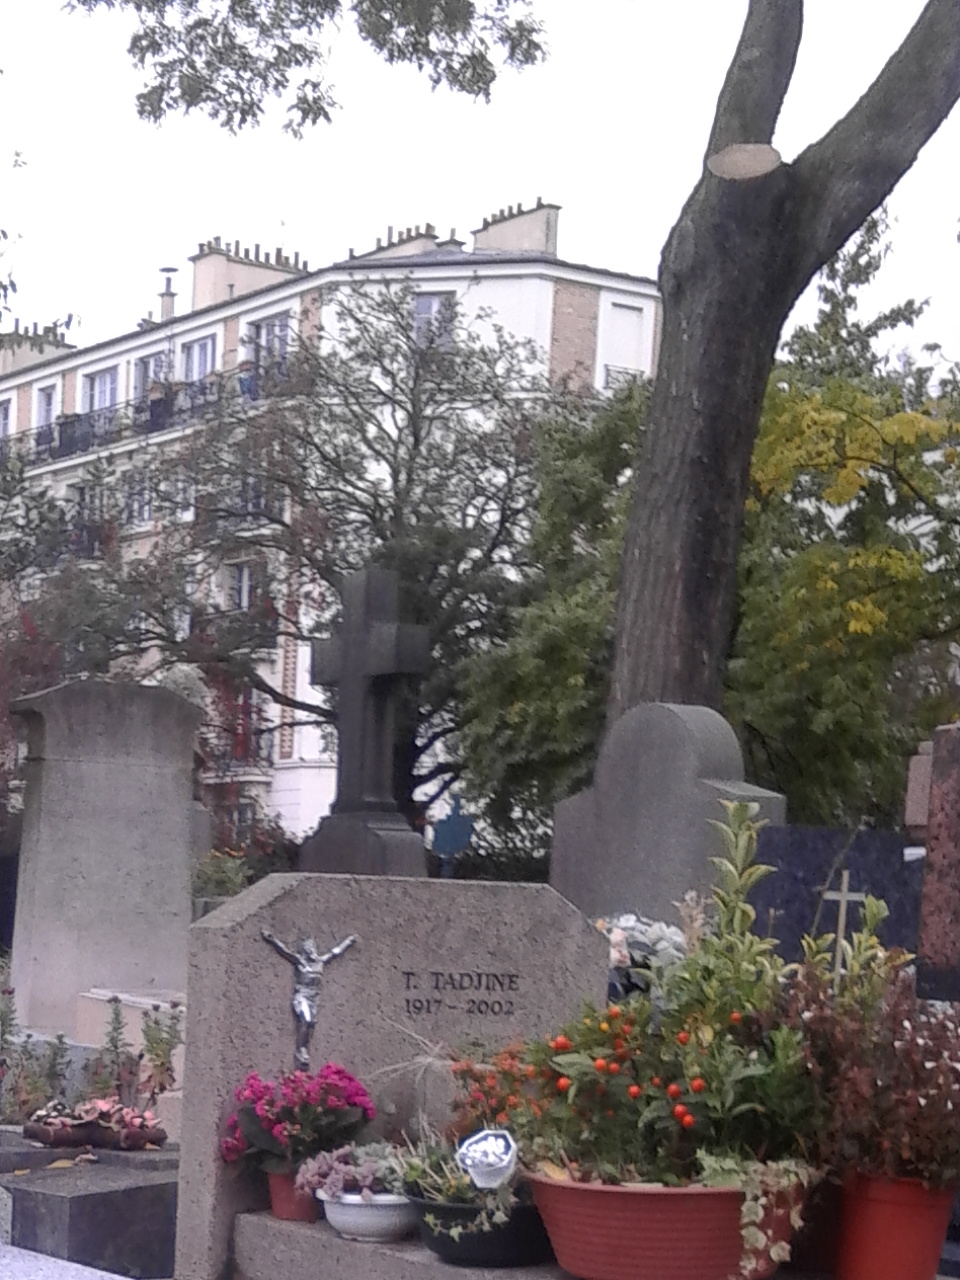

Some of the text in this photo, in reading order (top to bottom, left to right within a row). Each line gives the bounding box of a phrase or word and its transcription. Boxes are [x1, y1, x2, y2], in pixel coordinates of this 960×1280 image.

[402, 972, 520, 992] T. TADJINE
[405, 999, 442, 1015] 1917
[465, 1000, 515, 1016] 2002
